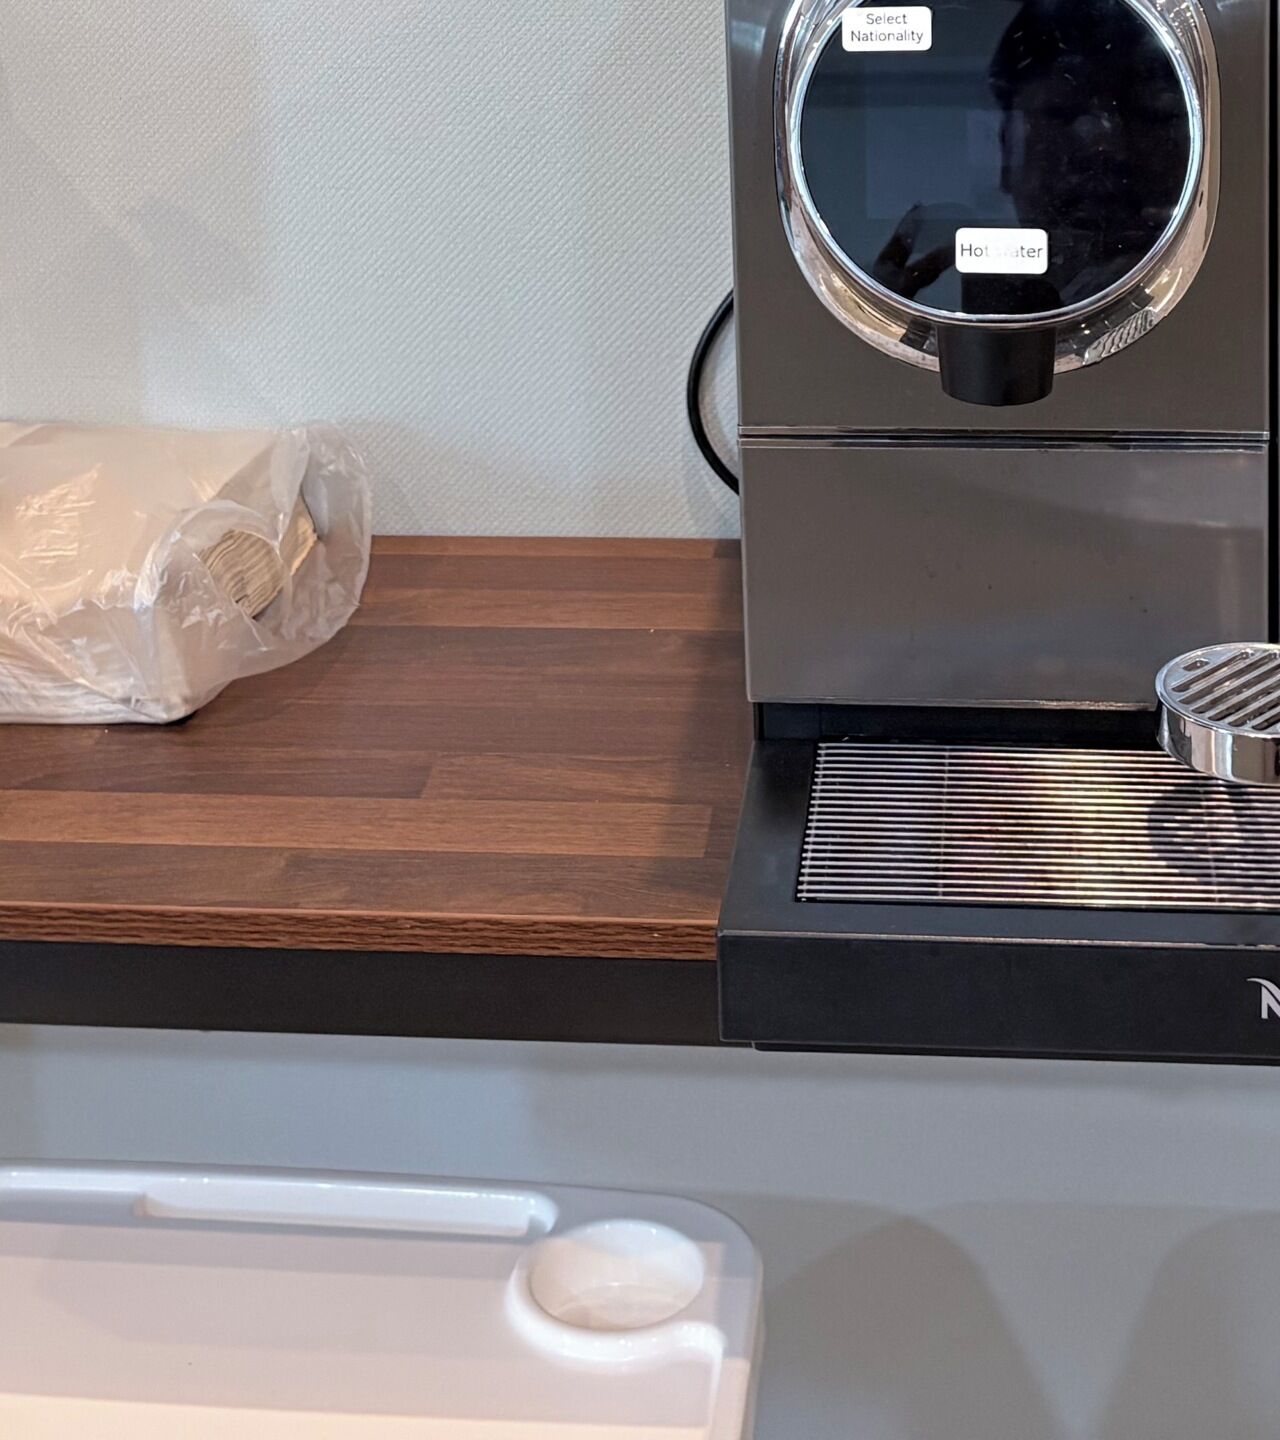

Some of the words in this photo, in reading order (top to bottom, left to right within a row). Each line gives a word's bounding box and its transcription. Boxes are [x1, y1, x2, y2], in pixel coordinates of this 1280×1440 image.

[866, 13, 908, 25] Select
[851, 29, 924, 44] Nationality
[960, 243, 989, 258] Hot
